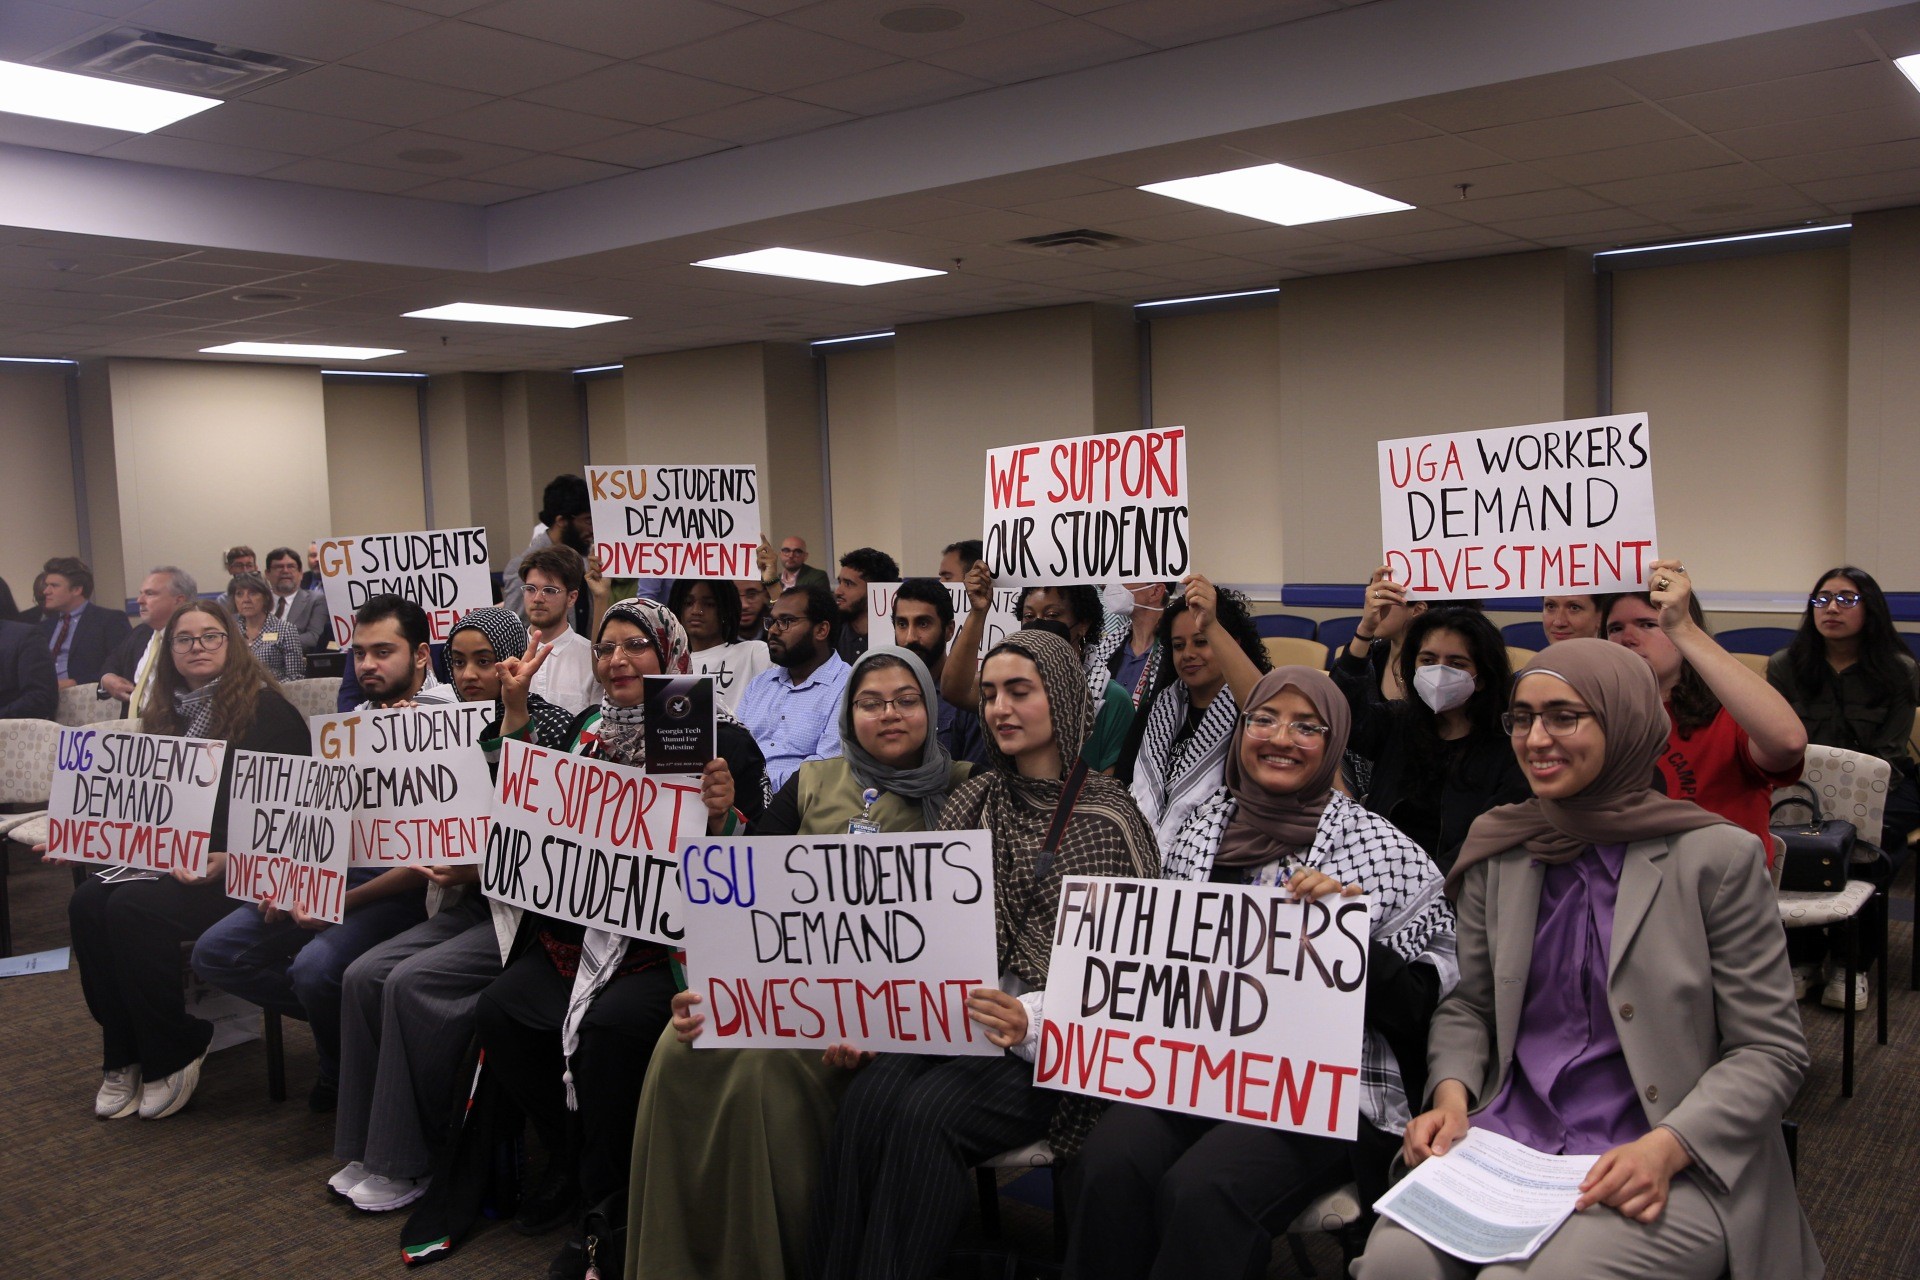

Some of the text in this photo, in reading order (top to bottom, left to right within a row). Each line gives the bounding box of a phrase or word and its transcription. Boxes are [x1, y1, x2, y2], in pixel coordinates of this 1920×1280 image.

[990, 429, 1184, 510] WE SUPPORT
[1388, 422, 1648, 488] UGA WORKERS
[590, 468, 756, 504] KSU STUDENTS
[1407, 477, 1619, 542] DEMAND
[625, 505, 734, 540] DEMAND
[985, 505, 1188, 579] OUR STUDENTS
[319, 528, 488, 577] GT STUDENTS
[597, 542, 757, 577] DIVESTMENT
[1386, 540, 1651, 592] DIVESTMENT
[58, 730, 226, 787] USG STUDENTS
[320, 716, 361, 759] GT
[73, 773, 173, 826] DEMAND
[232, 755, 357, 812] FAITH LEADERS
[502, 741, 702, 854] WE SUPPORT
[1667, 752, 1697, 801] CAMP
[48, 818, 211, 871] DIVESTMENT
[252, 808, 335, 863] DEMAND
[352, 815, 491, 861] IVESTMENT
[484, 821, 532, 902] OUR
[228, 852, 345, 922] DIVESTMENT!
[683, 840, 983, 908] GSU STUDENTS
[751, 909, 926, 965] DEMAND
[1056, 881, 1367, 993] FAITH LEADERS
[708, 976, 983, 1042] DIVESTMENT
[1081, 956, 1268, 1036] DEMAND
[1036, 1018, 1358, 1132] DIVESTMENT
